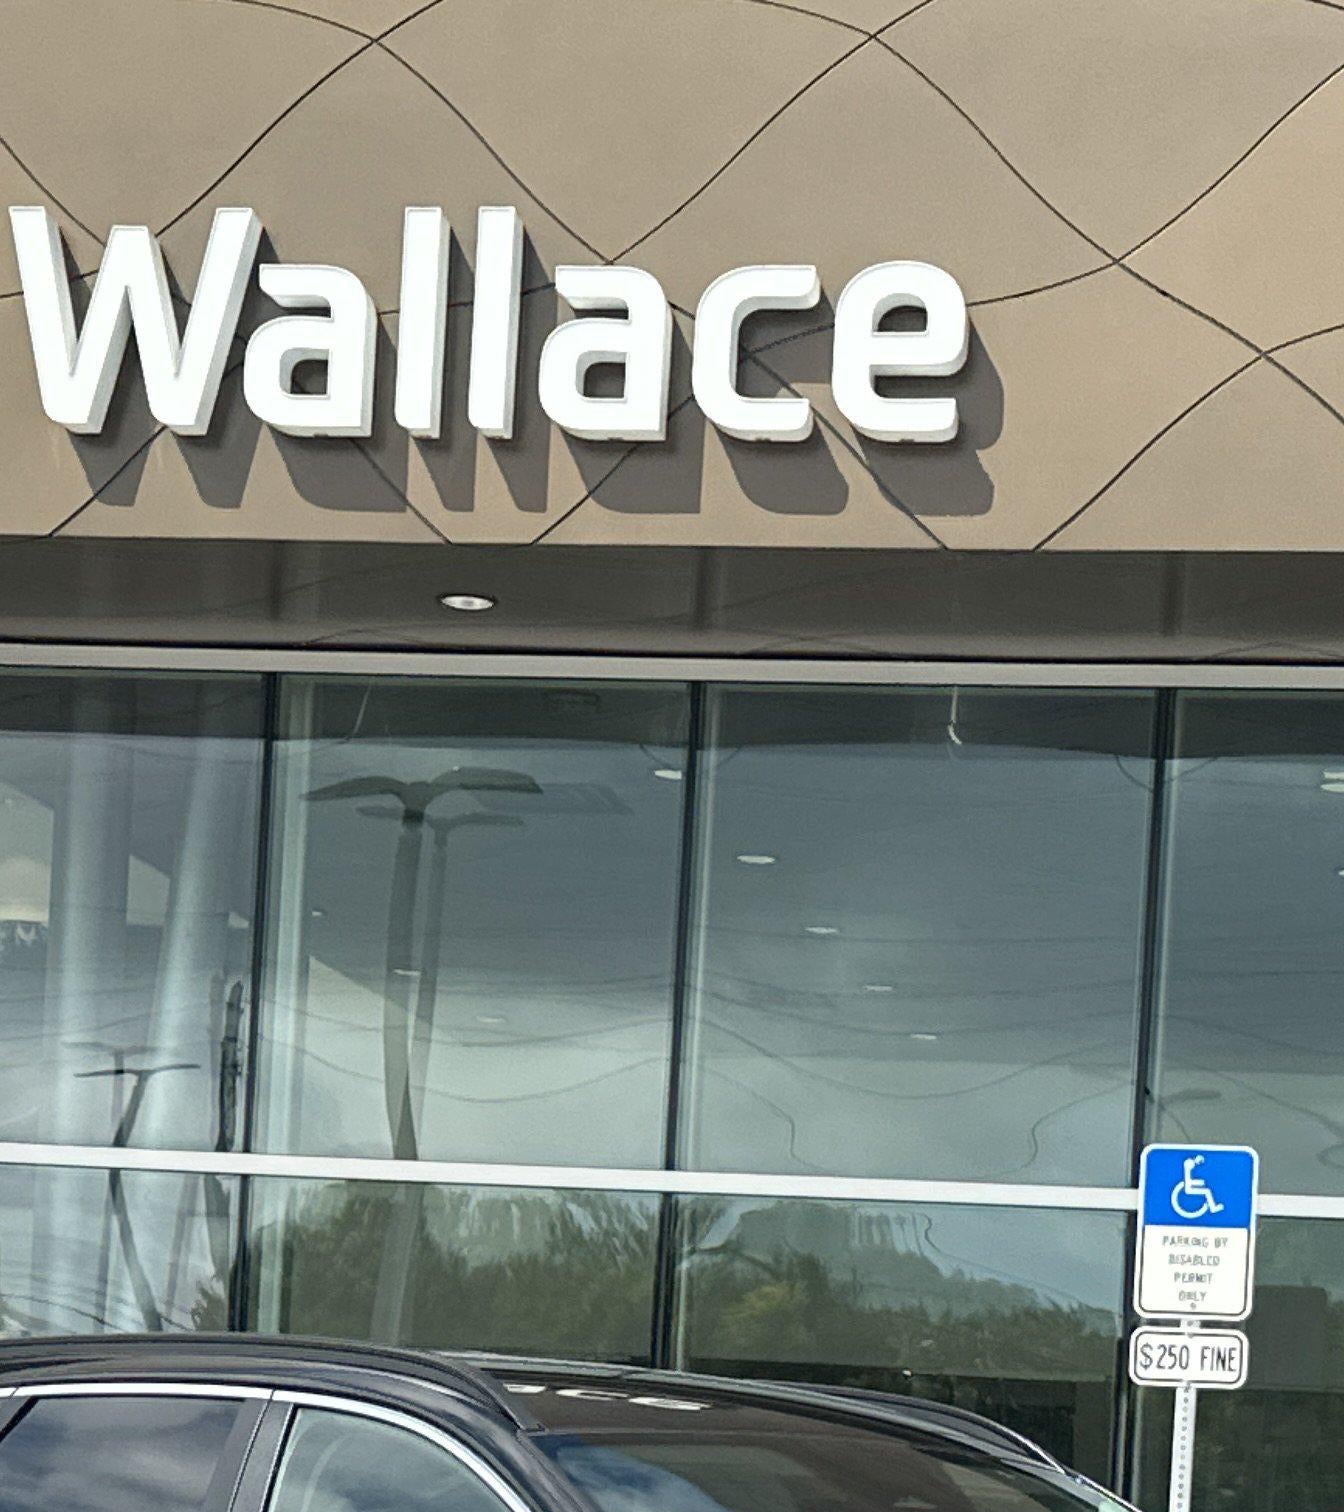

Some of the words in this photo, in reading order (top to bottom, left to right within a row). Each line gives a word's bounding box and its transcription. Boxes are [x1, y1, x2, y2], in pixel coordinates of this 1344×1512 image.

[9, 206, 968, 443] Wallace
[1162, 1235, 1209, 1248] PARKING
[1214, 1237, 1228, 1248] BY
[1168, 1254, 1220, 1266] DISABLED
[1174, 1272, 1213, 1284] PERMIT
[1178, 1290, 1207, 1302] ONLY
[1140, 1342, 1190, 1370] $250
[1200, 1345, 1237, 1373] FINE
